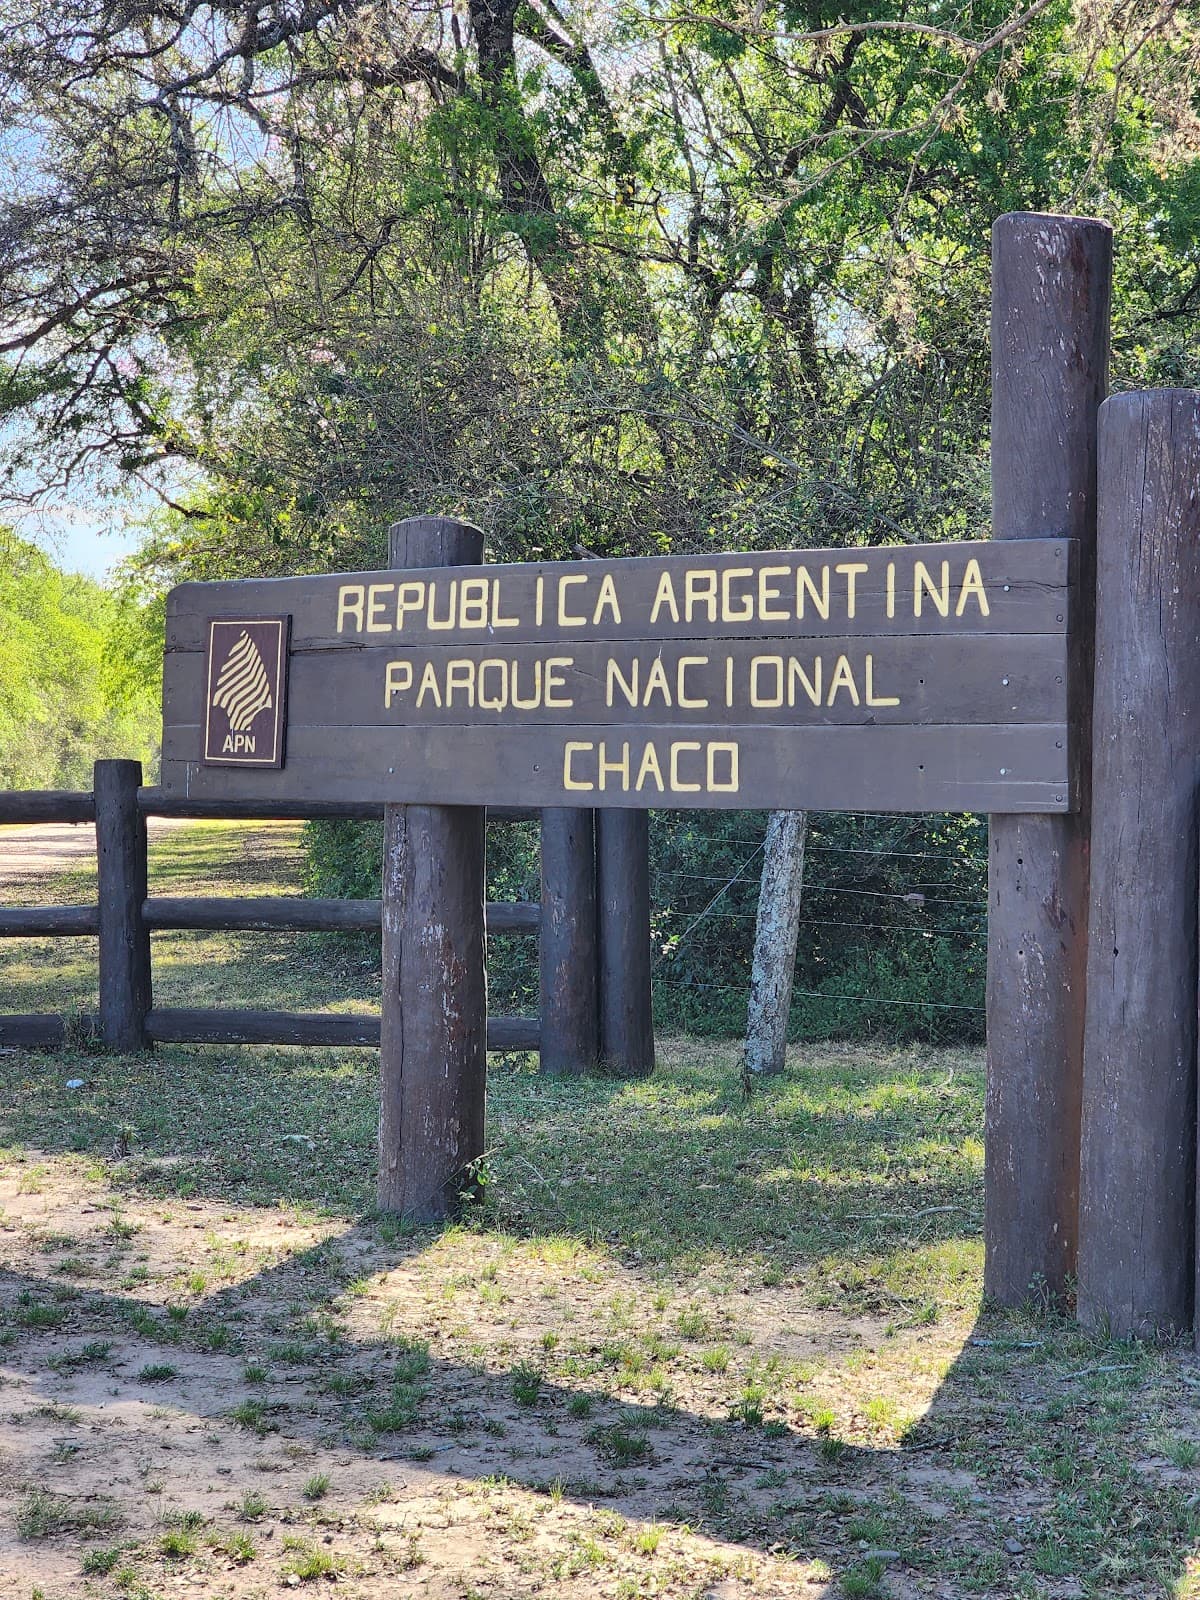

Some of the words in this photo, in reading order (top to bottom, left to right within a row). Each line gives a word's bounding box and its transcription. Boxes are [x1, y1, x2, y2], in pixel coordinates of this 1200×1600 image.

[336, 573, 622, 633] REPUBLICA
[649, 558, 990, 625] ARGENTINA
[384, 657, 575, 713] PARQUE
[605, 654, 901, 709] NACIONAL
[222, 734, 256, 753] APN
[563, 741, 740, 793] CHACO
